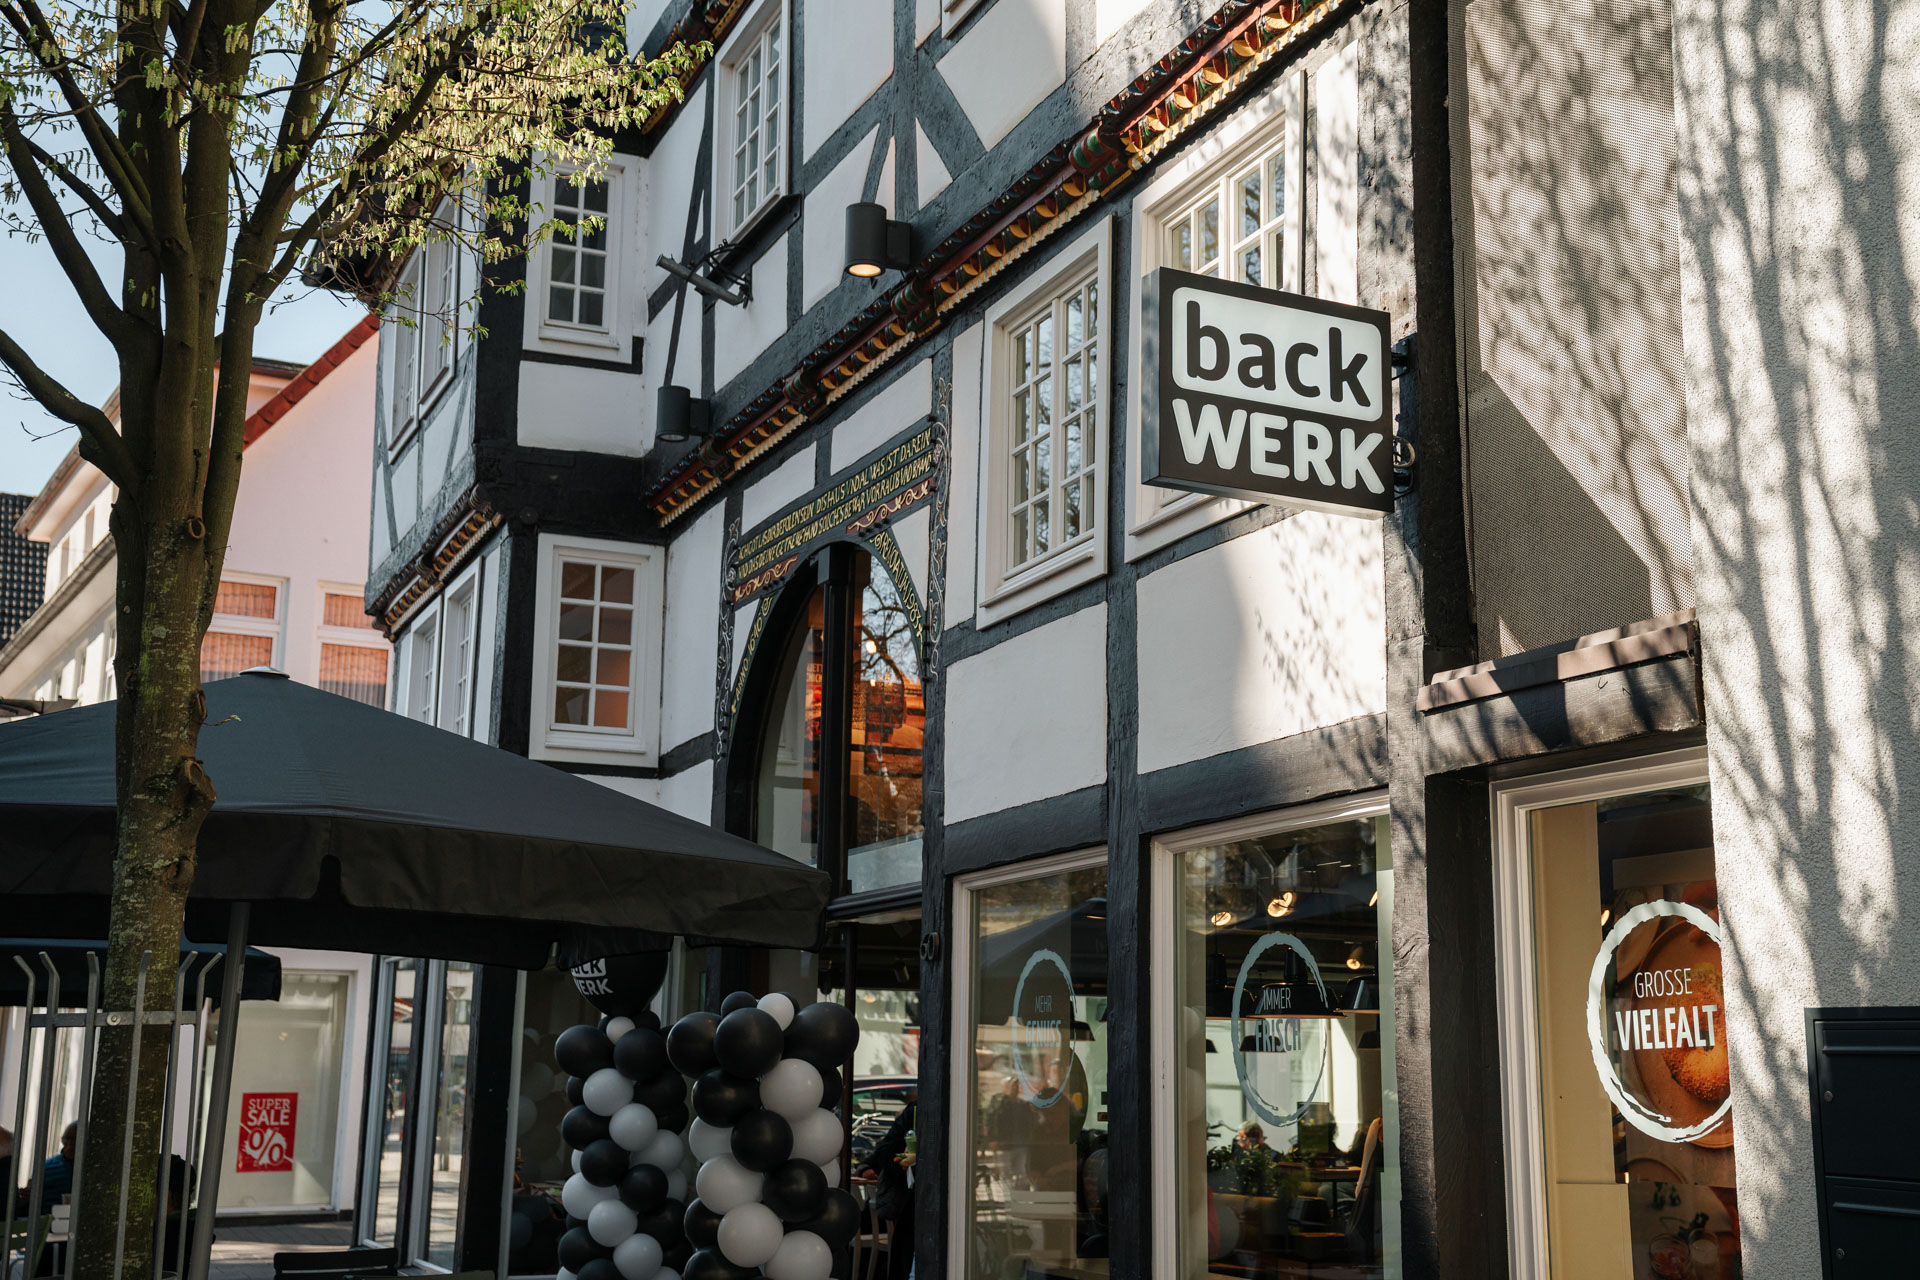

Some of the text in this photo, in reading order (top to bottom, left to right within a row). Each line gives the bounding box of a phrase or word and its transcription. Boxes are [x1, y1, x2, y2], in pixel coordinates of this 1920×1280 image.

[1187, 300, 1371, 407] back
[1172, 398, 1385, 494] WERK
[735, 658, 749, 702] ANNO
[1263, 987, 1292, 1011] IMMER
[1634, 968, 1692, 999] GROSSE
[1034, 994, 1052, 1013] MEHR
[1025, 1019, 1062, 1048] GENUSS
[1255, 1017, 1302, 1052] FRISCH
[1615, 1004, 1718, 1051] VIELFALT
[247, 1109, 290, 1126] SALE
[248, 1098, 291, 1111] SUPER
